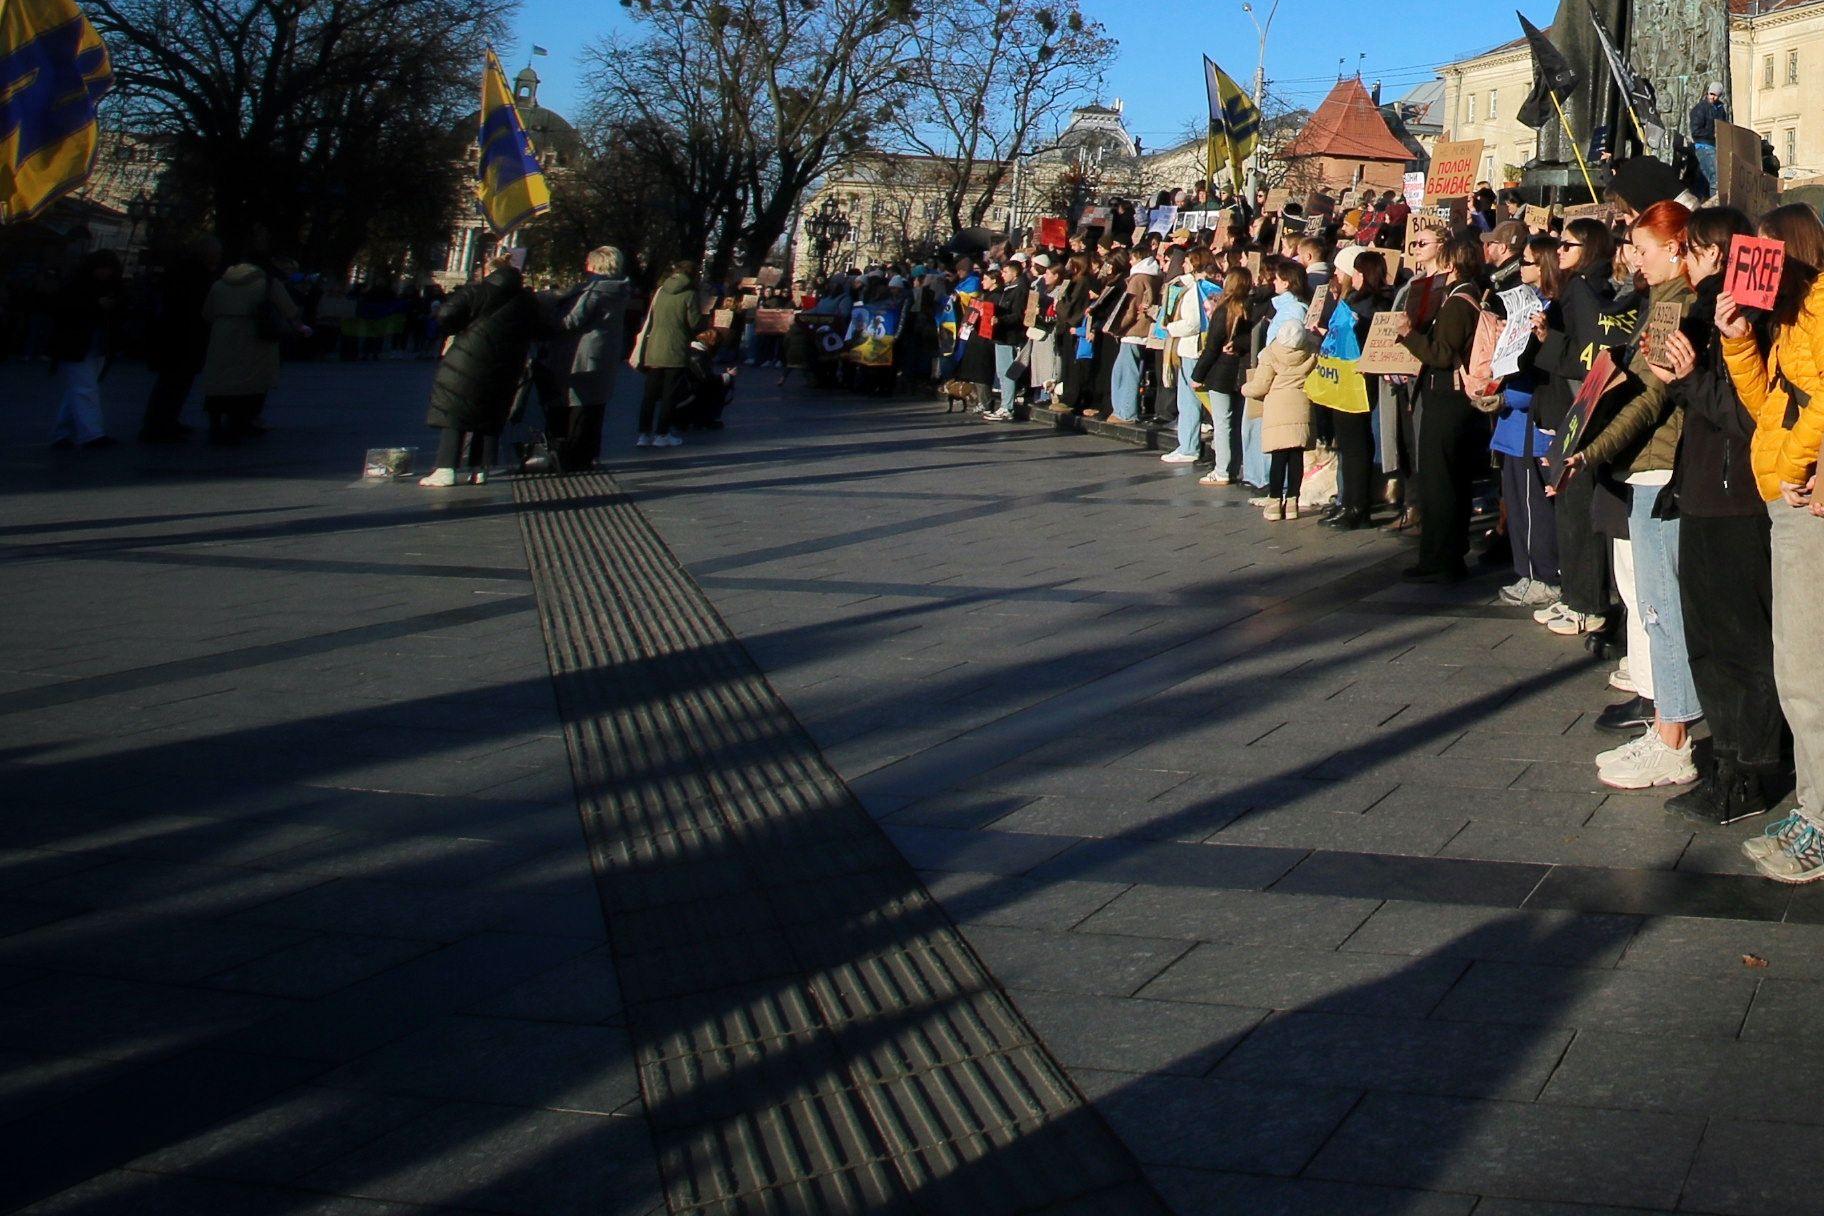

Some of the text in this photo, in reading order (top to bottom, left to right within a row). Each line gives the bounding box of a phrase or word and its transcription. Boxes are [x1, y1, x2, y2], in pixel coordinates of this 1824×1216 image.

[1437, 158, 1472, 175] ПОЛОН
[1426, 174, 1473, 195] ВБИВАЄ
[1732, 245, 1782, 293] FREE
